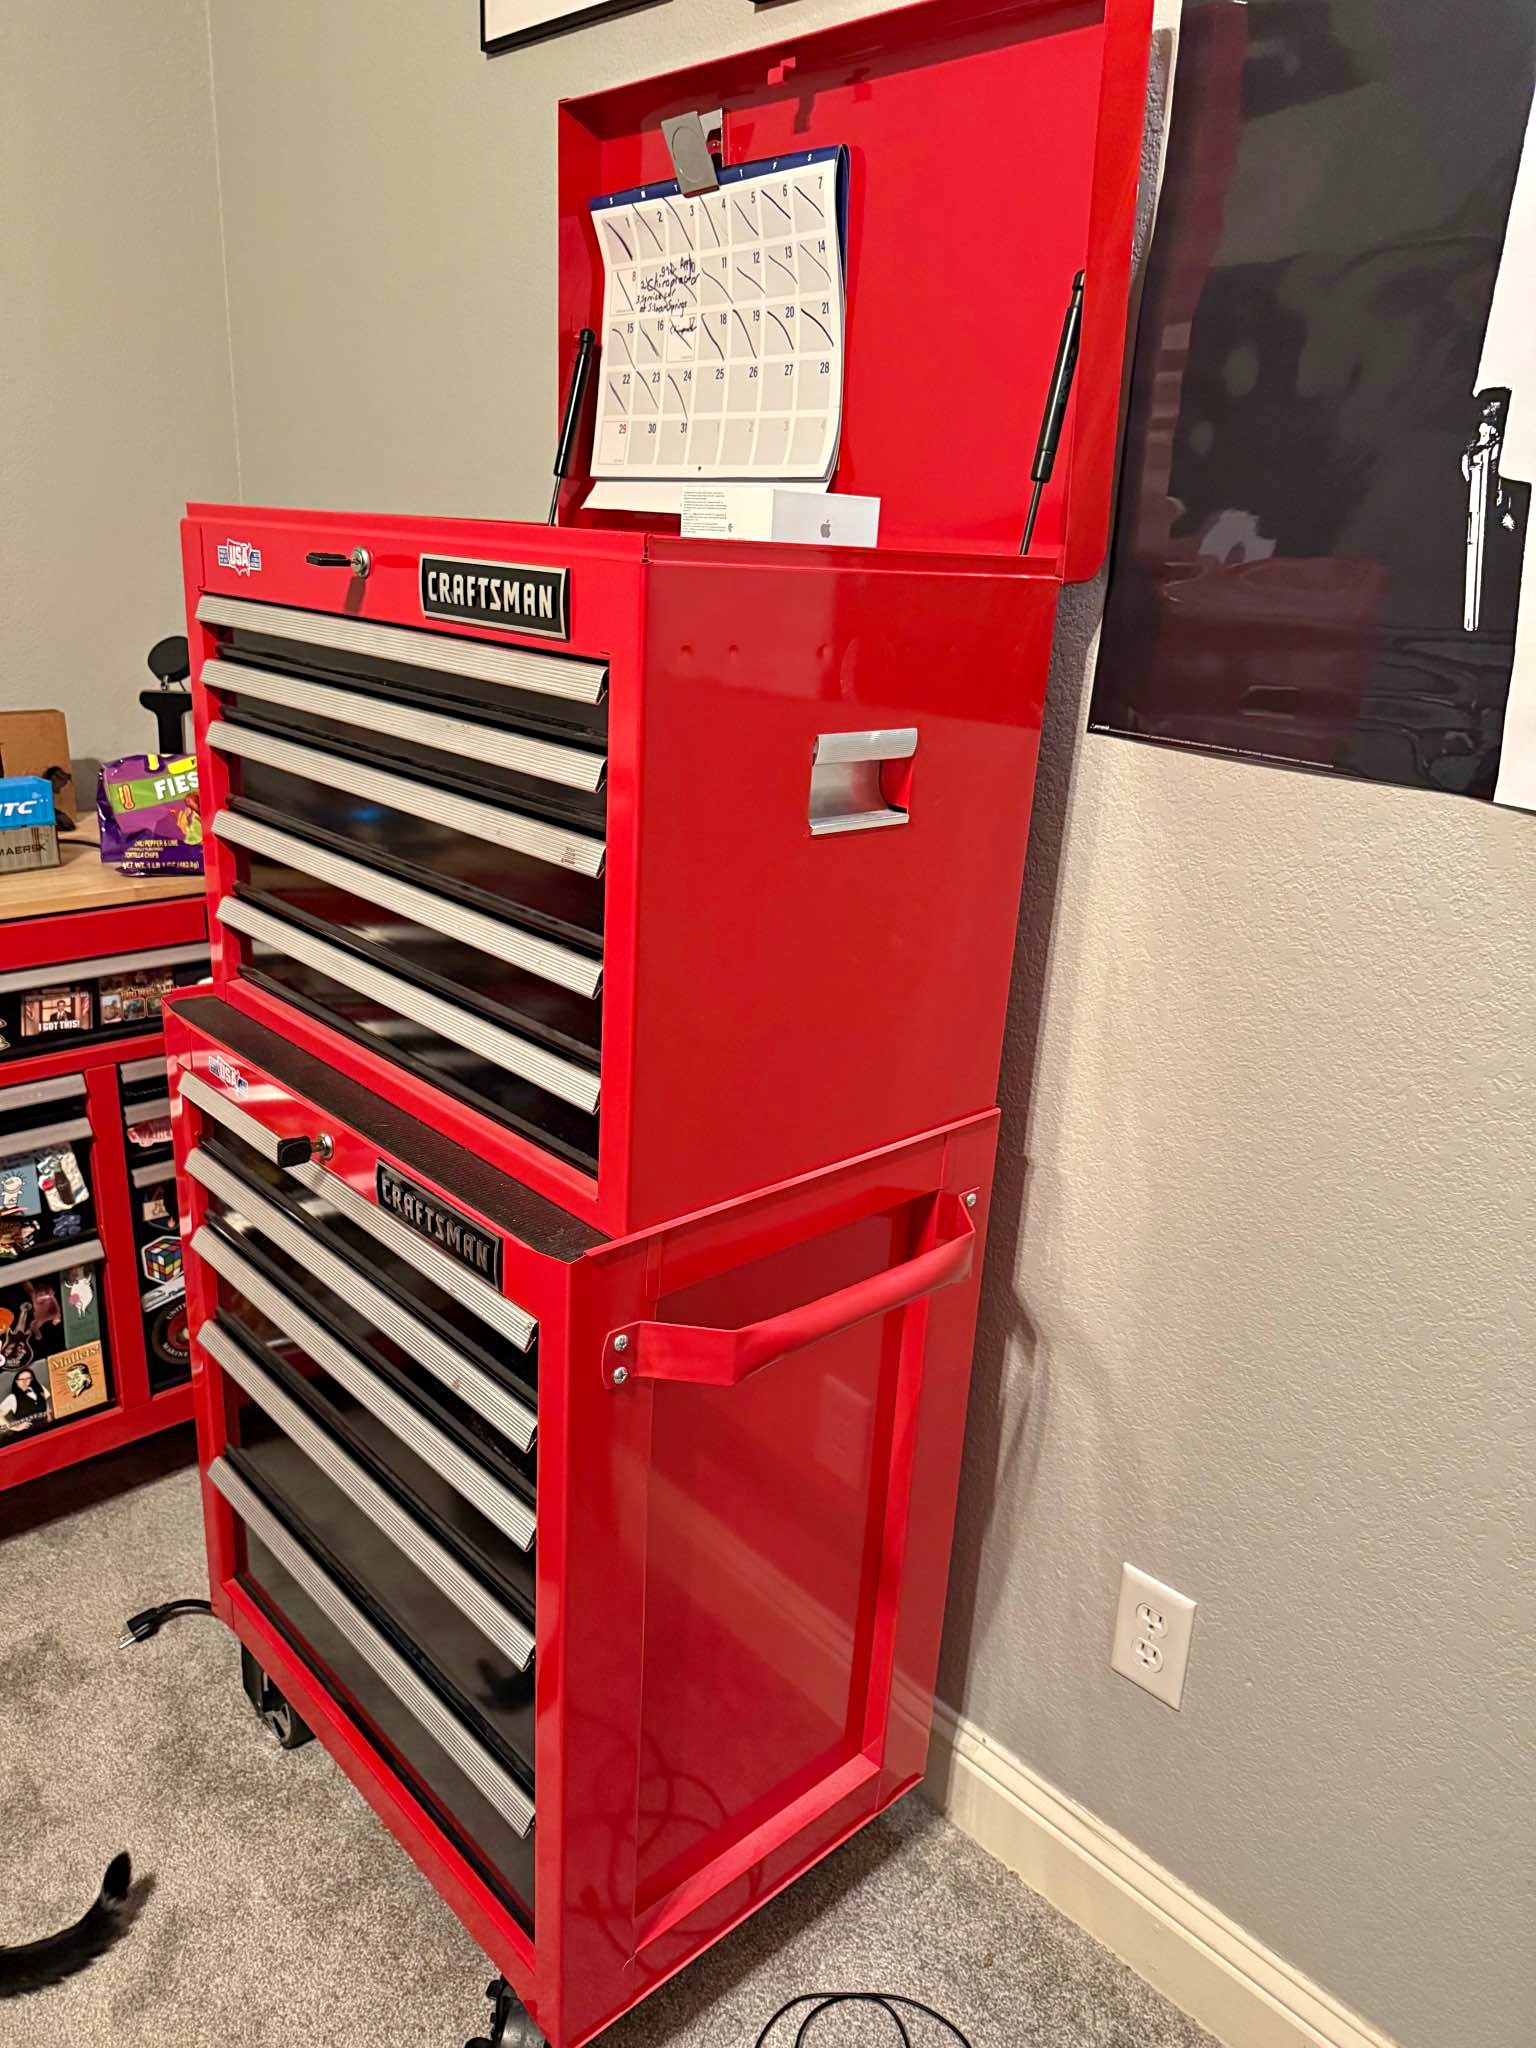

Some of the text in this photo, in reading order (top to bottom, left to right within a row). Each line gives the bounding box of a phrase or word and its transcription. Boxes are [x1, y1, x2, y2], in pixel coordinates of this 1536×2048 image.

[656, 210, 664, 223] 2
[689, 204, 695, 217] 3
[721, 198, 727, 209] 4
[750, 191, 756, 204] 5
[782, 184, 788, 197] 6
[818, 175, 824, 190] 7
[631, 270, 637, 282] 8
[721, 256, 728, 269] 11
[752, 251, 761, 265] 12
[784, 245, 793, 259] 13
[817, 240, 826, 253] 14
[627, 322, 634, 334] 15
[657, 320, 664, 331] 16
[720, 313, 727, 325] 18
[752, 309, 760, 322] 19
[785, 305, 795, 319] 20
[821, 302, 829, 315] 21
[622, 361, 830, 385] 22 23 24 25 26 27 28
[618, 423, 627, 434] 29
[648, 423, 657, 434] 30
[680, 422, 688, 434] 31
[229, 544, 250, 567] USA
[427, 571, 554, 619] CRAFTSMAN
[42, 1019, 59, 1032] GOT
[59, 1018, 81, 1031] THIS!
[381, 1177, 490, 1274] CRAFTSMAN
